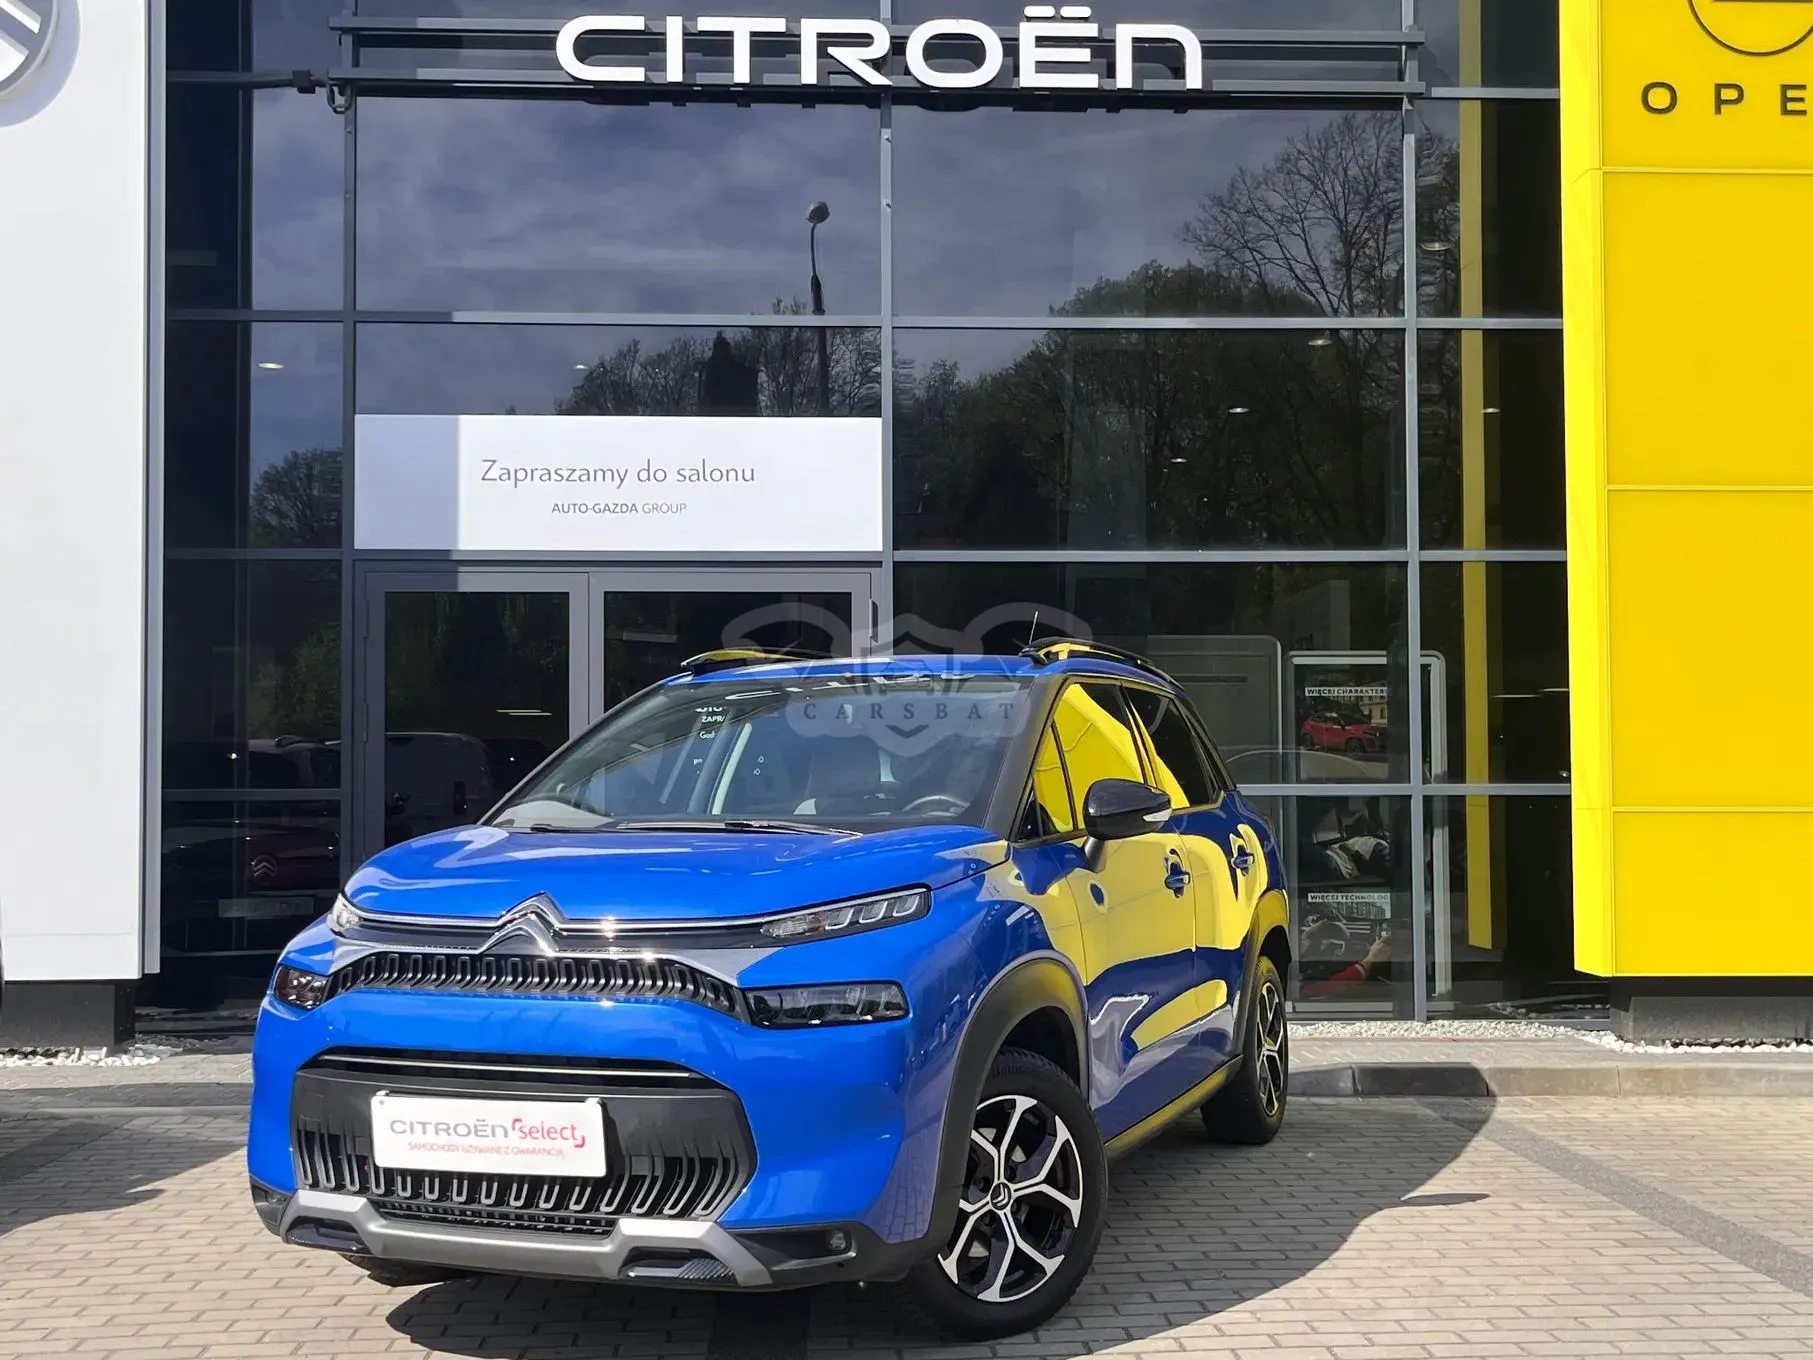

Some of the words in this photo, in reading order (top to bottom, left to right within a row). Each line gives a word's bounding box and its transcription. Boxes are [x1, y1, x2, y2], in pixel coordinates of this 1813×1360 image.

[480, 458, 629, 489] Zapraszamy
[636, 458, 668, 483] do
[675, 458, 755, 483] salonu
[551, 502, 639, 514] AUTO-GAZDA
[641, 502, 687, 514] GROUP
[518, 1123, 577, 1141] select
